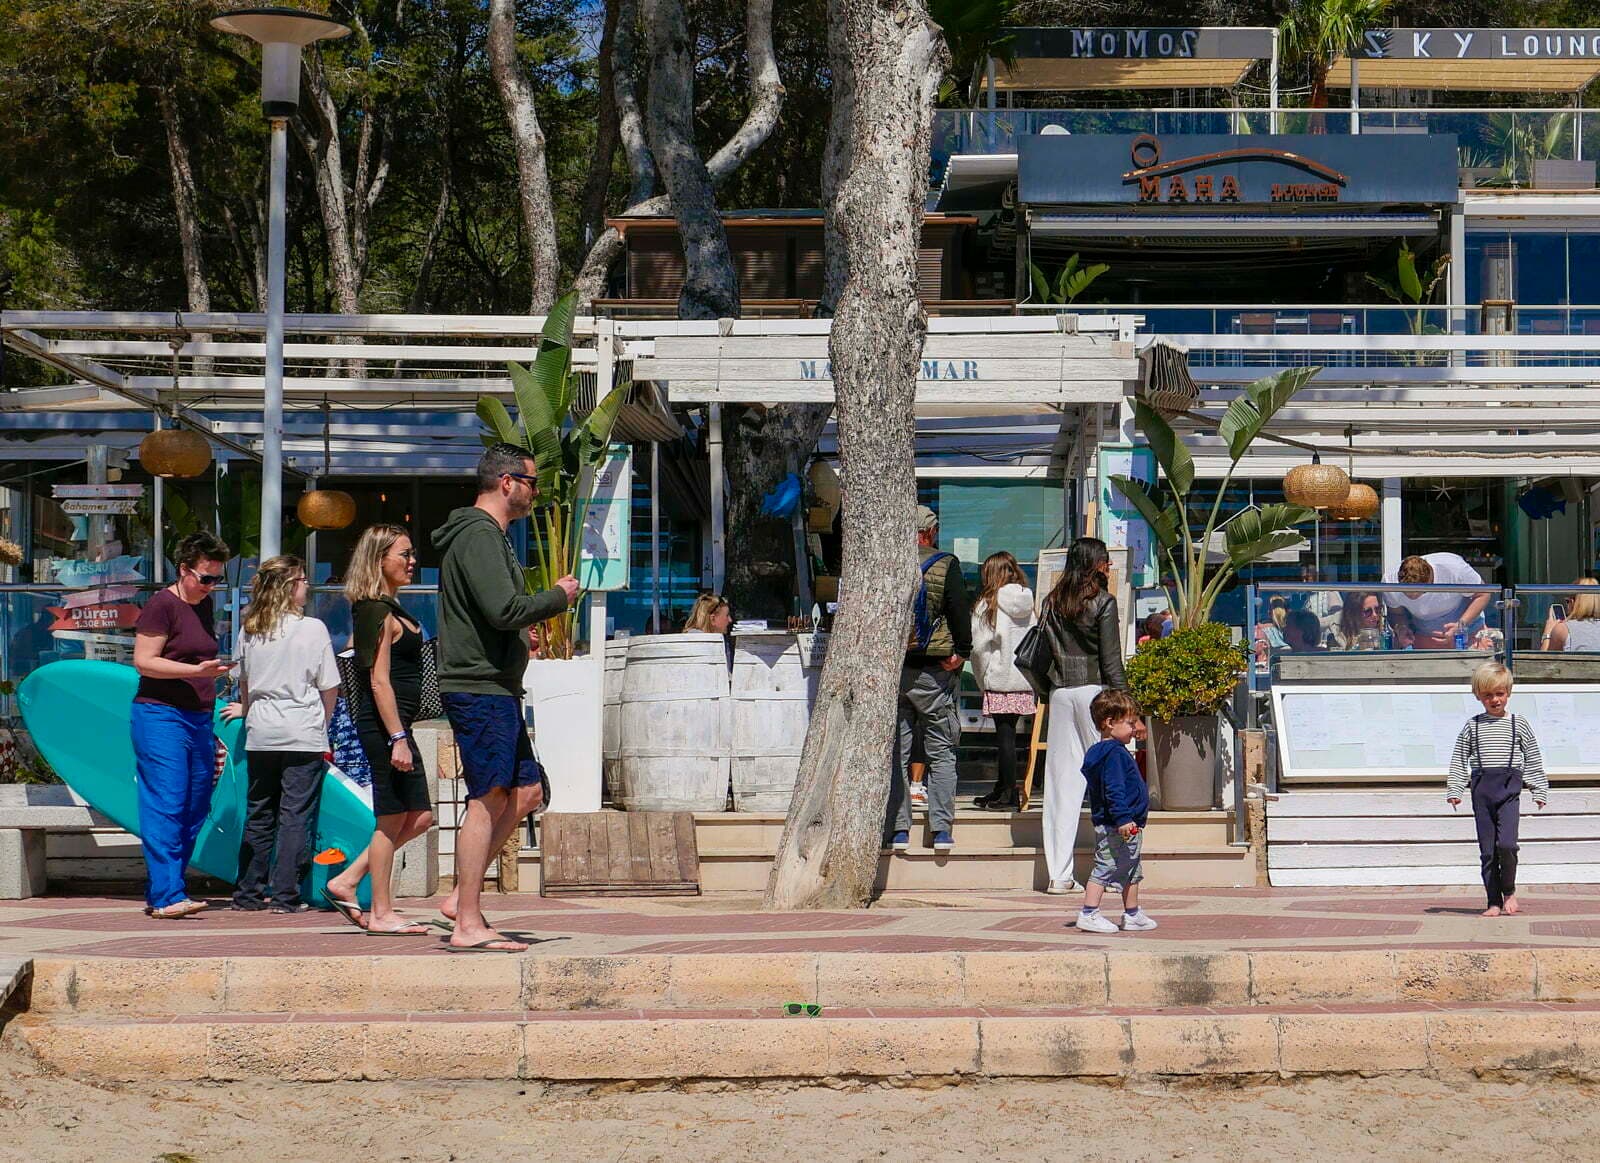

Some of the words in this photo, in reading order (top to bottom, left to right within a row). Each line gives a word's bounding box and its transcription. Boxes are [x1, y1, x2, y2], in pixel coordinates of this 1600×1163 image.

[1139, 175, 1241, 199] MAHA
[800, 360, 833, 379] MA
[922, 360, 979, 379] MAR
[71, 608, 118, 620] Düren
[102, 619, 116, 627] km
